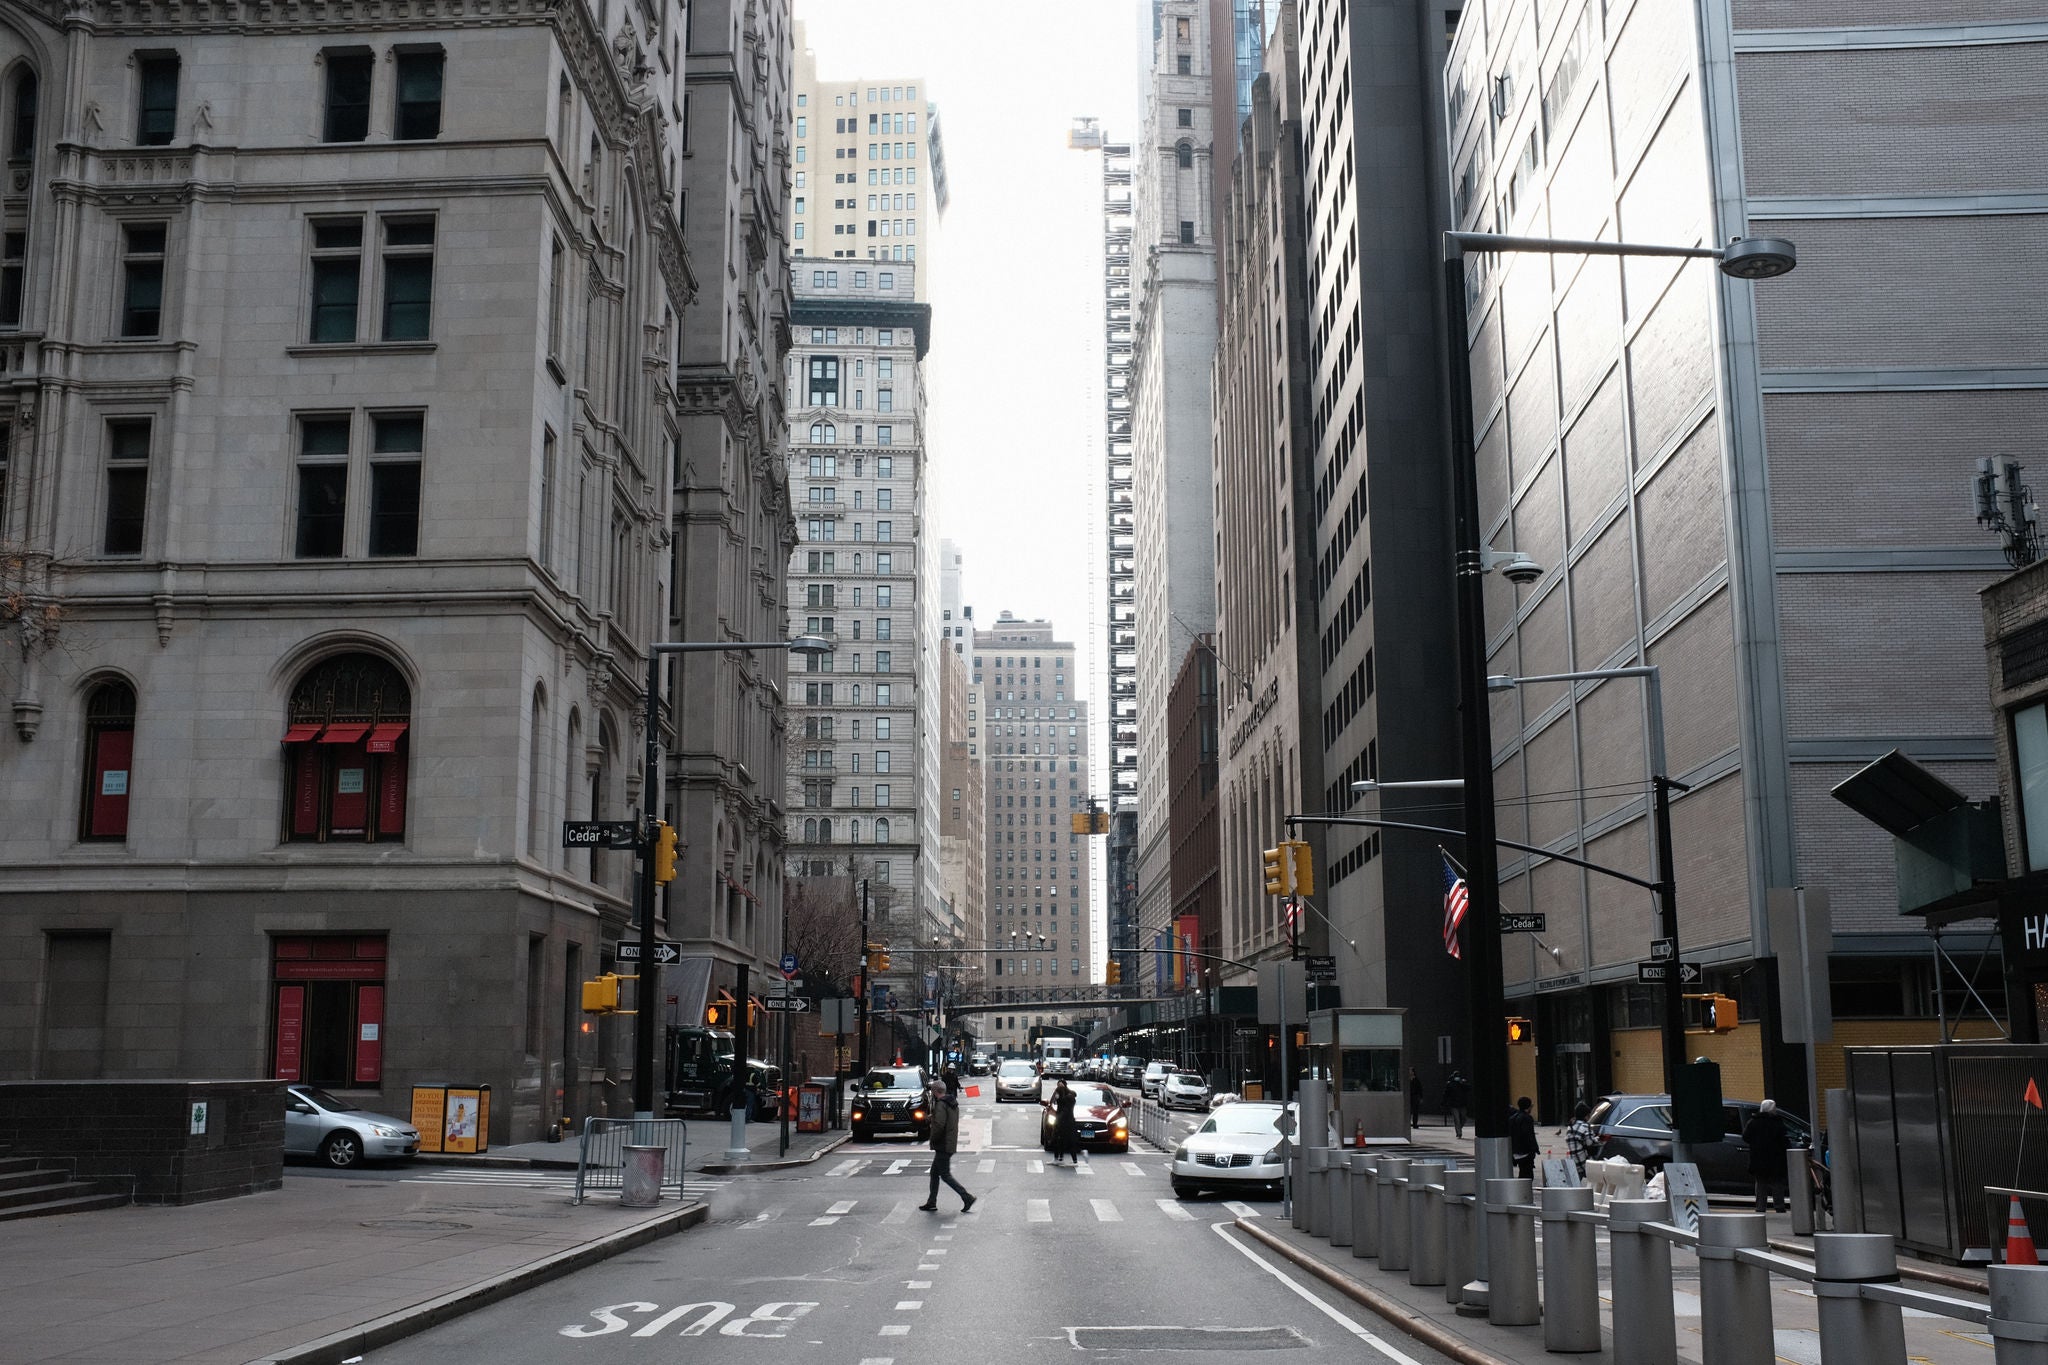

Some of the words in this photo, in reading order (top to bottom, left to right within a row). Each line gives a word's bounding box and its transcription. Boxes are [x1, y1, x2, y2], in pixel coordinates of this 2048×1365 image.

[568, 829, 601, 842] Cedar
[1512, 919, 1536, 928] Cedar
[770, 1000, 785, 1008] ONE
[789, 1000, 804, 1008] WAY
[559, 1301, 820, 1339] BUS
